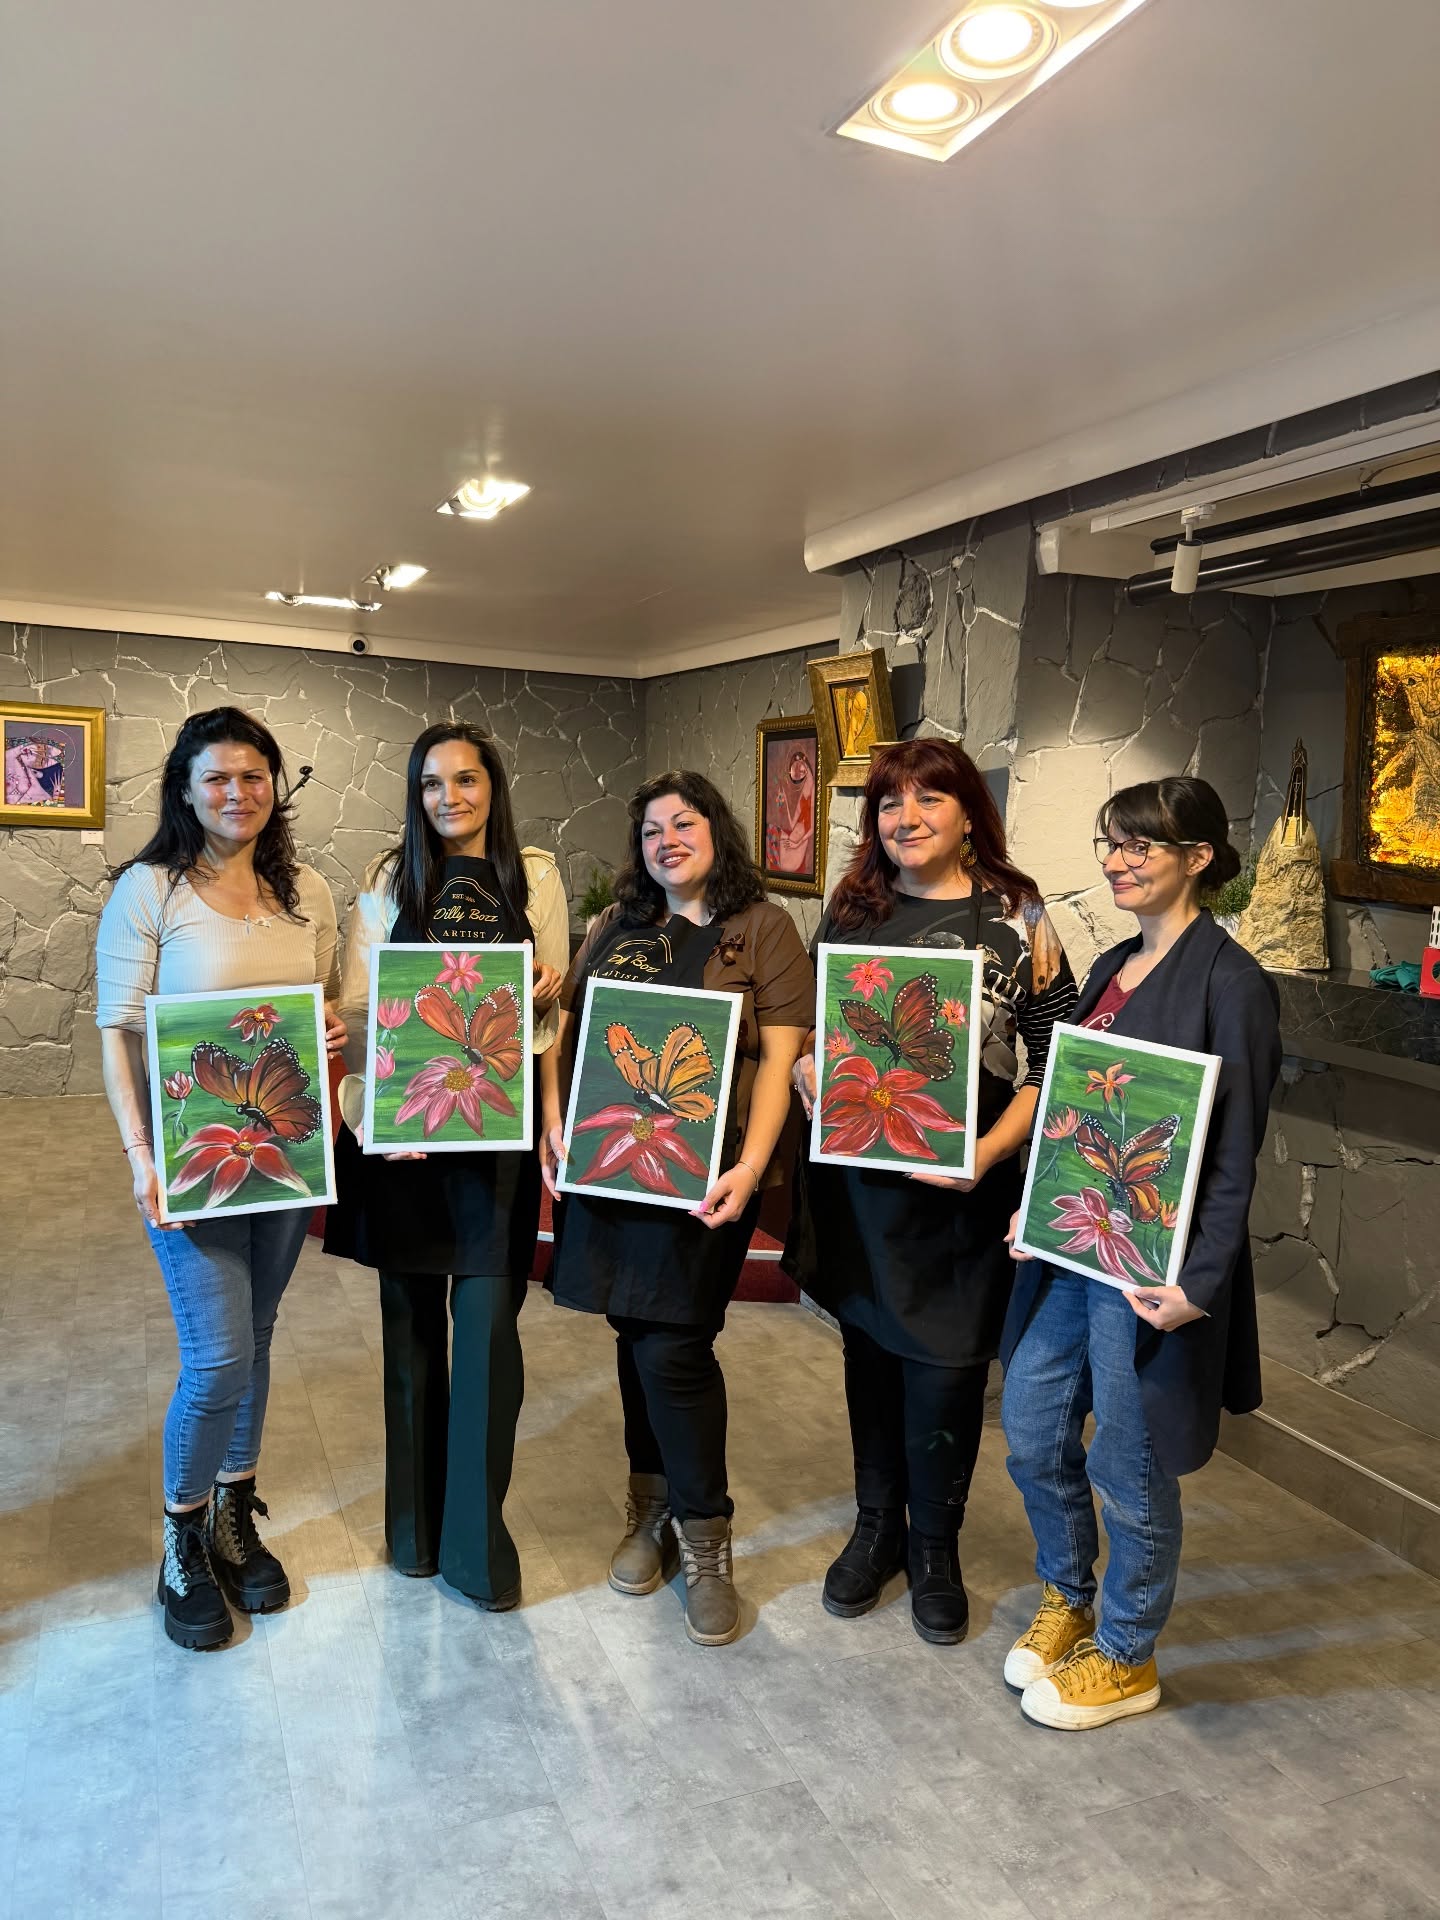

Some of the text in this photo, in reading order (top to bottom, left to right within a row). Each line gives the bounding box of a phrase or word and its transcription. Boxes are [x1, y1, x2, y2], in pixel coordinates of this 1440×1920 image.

[433, 905, 499, 923] Dilly Bozz
[442, 930, 487, 939] ARTIST
